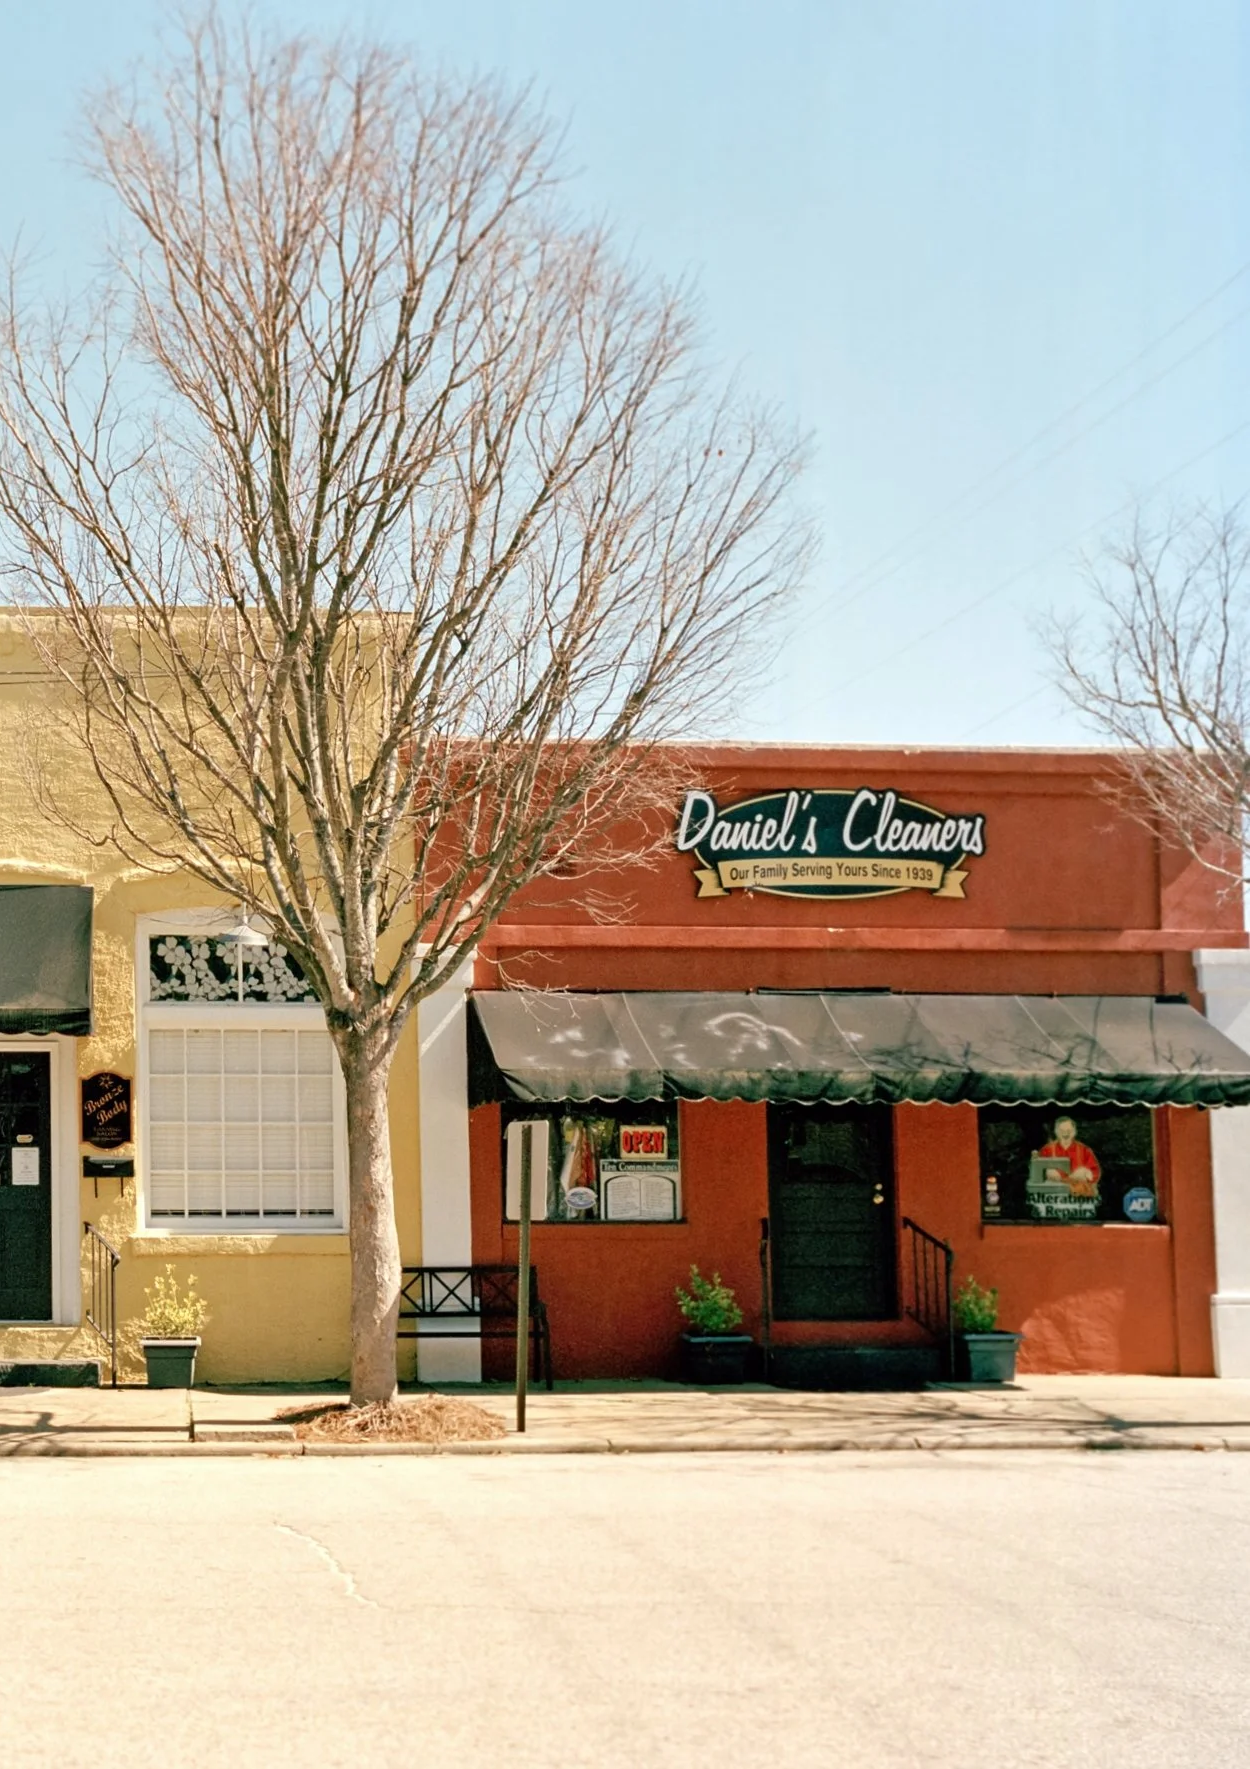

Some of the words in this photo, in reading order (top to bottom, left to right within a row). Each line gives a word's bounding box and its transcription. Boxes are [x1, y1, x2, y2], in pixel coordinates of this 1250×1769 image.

[677, 789, 817, 854] Daniel's
[843, 788, 985, 855] Cleaners
[730, 867, 749, 880] Our
[753, 864, 788, 879] Family
[792, 863, 832, 878] Serving
[836, 863, 868, 877] Yours
[872, 864, 901, 878] Since
[906, 867, 934, 881] 1939
[84, 1085, 124, 1116] Bronze
[96, 1100, 128, 1126] Body
[622, 1131, 665, 1154] OPEN
[602, 1162, 617, 1171] Ten
[618, 1162, 678, 1171] Commandments
[1046, 1205, 1096, 1219] Repairs
[1128, 1197, 1153, 1212] ADT
